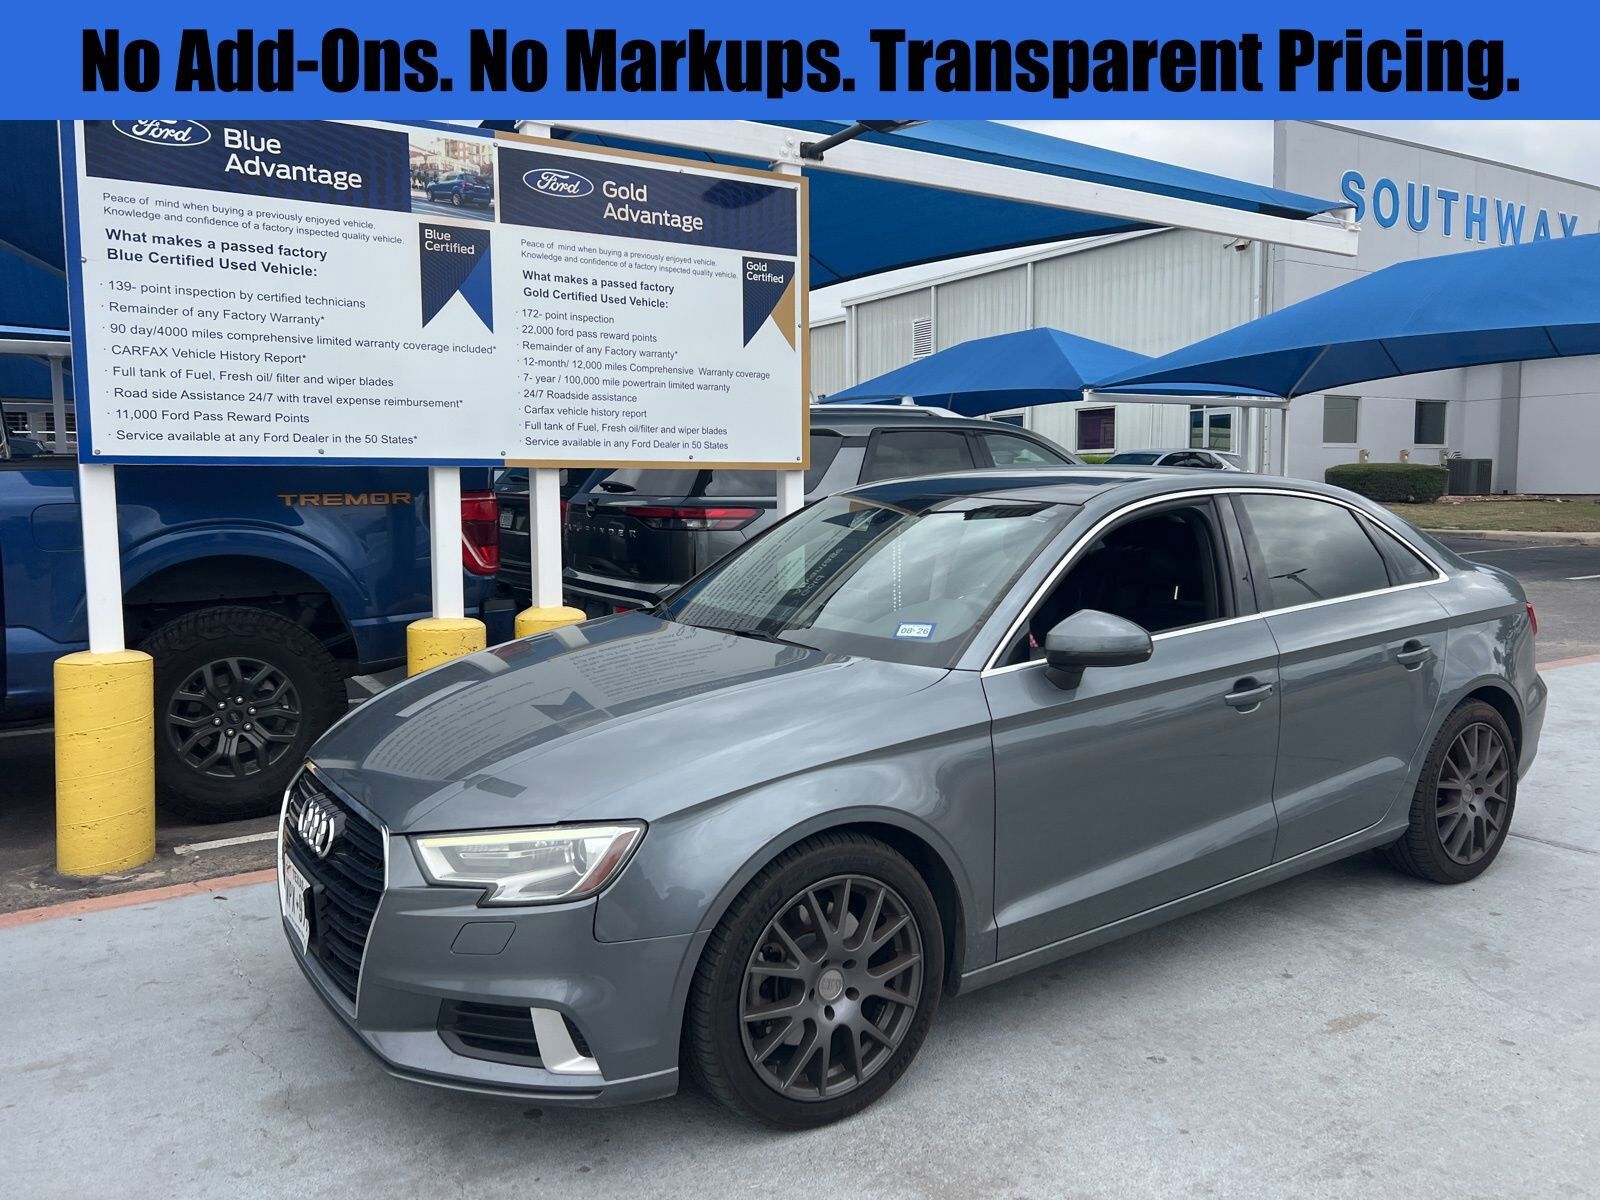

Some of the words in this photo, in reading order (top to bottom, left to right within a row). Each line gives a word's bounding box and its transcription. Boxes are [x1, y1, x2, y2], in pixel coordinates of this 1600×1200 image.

[132, 120, 192, 142] Ford
[225, 127, 281, 154] Blue
[225, 153, 362, 190] Advantage
[536, 171, 580, 195] Ford
[603, 180, 647, 202] Gold
[103, 192, 136, 204] Peace
[139, 197, 149, 205] of
[155, 199, 179, 208] mind
[182, 202, 209, 211] when
[212, 204, 244, 217] buying
[256, 211, 302, 223] previously
[306, 216, 340, 226] enjoyed
[343, 220, 375, 229] vehicle.
[603, 202, 704, 231] Advantage
[1340, 170, 1578, 246] SOUTHWAY
[104, 206, 160, 221] Knowledge
[164, 214, 182, 222] and
[186, 216, 238, 227] confidence
[262, 222, 294, 235] factory
[296, 226, 339, 238] inspected
[342, 233, 370, 242] quality
[373, 235, 404, 244] vehicle.
[425, 228, 451, 241] Blue
[105, 228, 147, 243] What
[152, 235, 202, 248] makes
[208, 241, 215, 249] a
[221, 242, 273, 254] passed
[278, 245, 327, 262] factory
[425, 240, 475, 255] Certified
[108, 248, 143, 262] Blue
[149, 252, 214, 268] Certified
[220, 258, 256, 271] Used
[261, 262, 316, 276] Vehicle:
[746, 261, 767, 272] Gold
[522, 270, 551, 281] What
[554, 274, 588, 285] makes
[601, 280, 637, 289] passed
[640, 281, 674, 295] factory
[746, 272, 784, 283] Certified
[141, 284, 171, 294] point
[175, 285, 236, 299] inspection
[240, 290, 253, 302] by
[257, 293, 301, 303] certified
[305, 296, 365, 308] technicians
[524, 287, 549, 298] Gold
[553, 290, 597, 302] Certified
[601, 294, 626, 304] Used
[629, 296, 668, 308] Vehicle:
[110, 302, 178, 315] Remainder
[182, 307, 194, 316] of
[198, 310, 219, 320] any
[224, 310, 266, 323] Factory
[545, 312, 567, 320] point
[570, 312, 614, 324] inspection
[110, 323, 126, 334] 90
[192, 329, 223, 339] miles
[227, 332, 313, 344] comprehensive
[317, 336, 351, 346] limited
[355, 340, 400, 351] warranty
[403, 342, 449, 353] coverage
[522, 325, 554, 335] 22,000
[556, 327, 574, 336] ford
[577, 330, 597, 339] pass
[600, 332, 629, 340] reward
[632, 334, 657, 343] points
[112, 345, 168, 357] CARFAX
[172, 348, 216, 359] Vehicle
[220, 350, 260, 364] History
[522, 341, 572, 352] Remainder
[575, 345, 584, 353] of
[586, 347, 602, 356] any
[605, 346, 637, 358] Factory
[113, 366, 135, 376] Full
[140, 368, 166, 378] tank
[170, 369, 182, 378] of
[186, 369, 215, 380] Fuel,
[220, 371, 252, 381] Fresh
[276, 373, 300, 383] filter
[304, 375, 323, 384] and
[327, 376, 356, 387] wiper
[360, 377, 394, 386] blades
[572, 360, 602, 370] 12,000
[605, 362, 627, 371] miles
[630, 363, 694, 375] Comprehensive
[698, 368, 734, 379] Warranty
[736, 371, 770, 380] coverage
[535, 376, 556, 384] year
[564, 376, 600, 385] 100,000
[602, 378, 620, 386] mile
[623, 380, 666, 388] powertrain
[669, 380, 694, 390] limited
[696, 384, 730, 393] warranty
[114, 388, 147, 398] Road
[152, 389, 177, 399] side
[180, 390, 245, 401] Assistance
[249, 392, 273, 402] 24/7
[277, 394, 299, 403] with
[303, 395, 332, 404] travel
[336, 397, 380, 406] expense
[524, 389, 544, 398] 24/7
[547, 390, 589, 400] Roadside
[592, 393, 637, 402] assistance
[116, 409, 157, 420] 11,000
[162, 410, 189, 420] Ford
[194, 411, 223, 421] Pass
[228, 412, 271, 422] Reward
[276, 413, 309, 423] Points
[116, 430, 163, 440] Service
[168, 432, 220, 441] available
[225, 433, 236, 441] at
[239, 434, 260, 444] any
[264, 433, 289, 442] Ford
[293, 433, 329, 443] Dealer
[332, 434, 341, 443] in
[345, 434, 361, 443] the
[365, 434, 378, 443] 50
[525, 421, 541, 430] Full
[544, 422, 563, 430] tank
[566, 422, 575, 431] of
[578, 422, 599, 432] Fuel,
[602, 424, 626, 432] Fresh
[628, 424, 658, 433] oil/filter
[661, 426, 676, 434] and
[678, 426, 700, 436] wiper
[702, 426, 727, 435] blades
[276, 492, 411, 506] TREMOR
